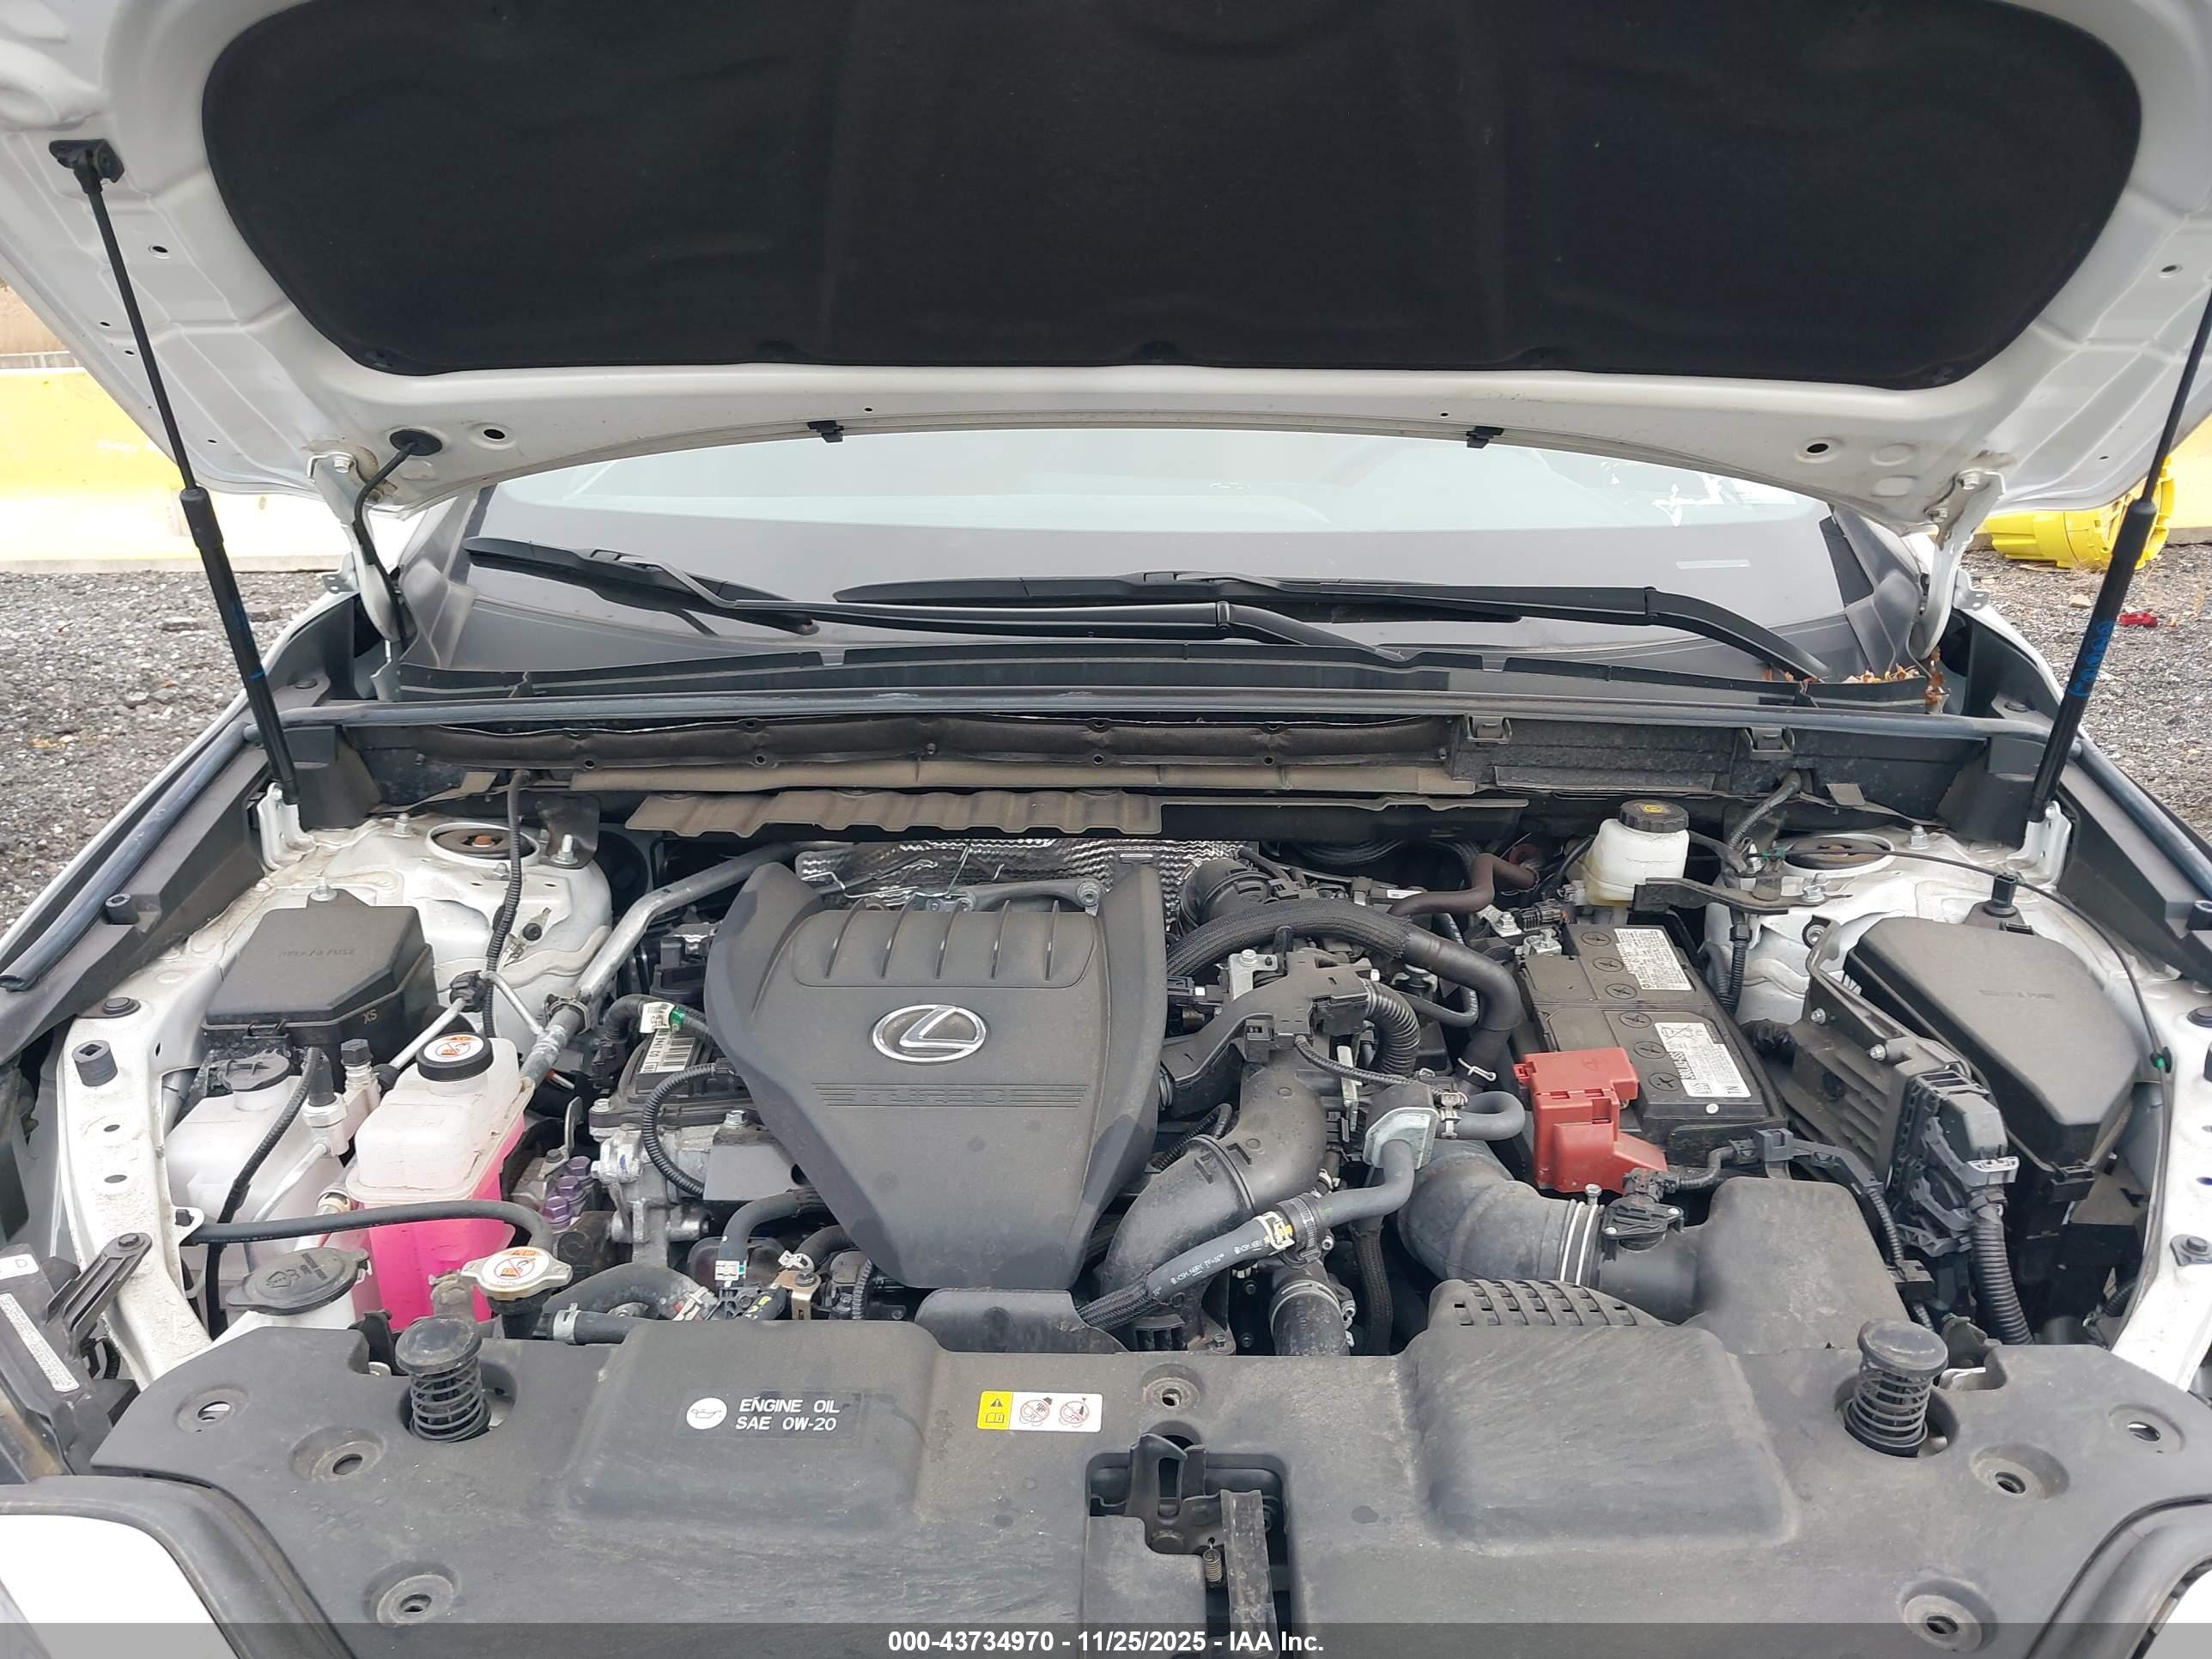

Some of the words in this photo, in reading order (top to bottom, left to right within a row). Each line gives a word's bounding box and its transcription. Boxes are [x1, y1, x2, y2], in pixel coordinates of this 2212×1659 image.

[363, 1009, 378, 1024] XS
[859, 1088, 1005, 1104] TURBO
[739, 1399, 804, 1413] ENGINE
[814, 1400, 841, 1413] OIL
[735, 1416, 773, 1431] SAE
[782, 1417, 837, 1431] 0W-20
